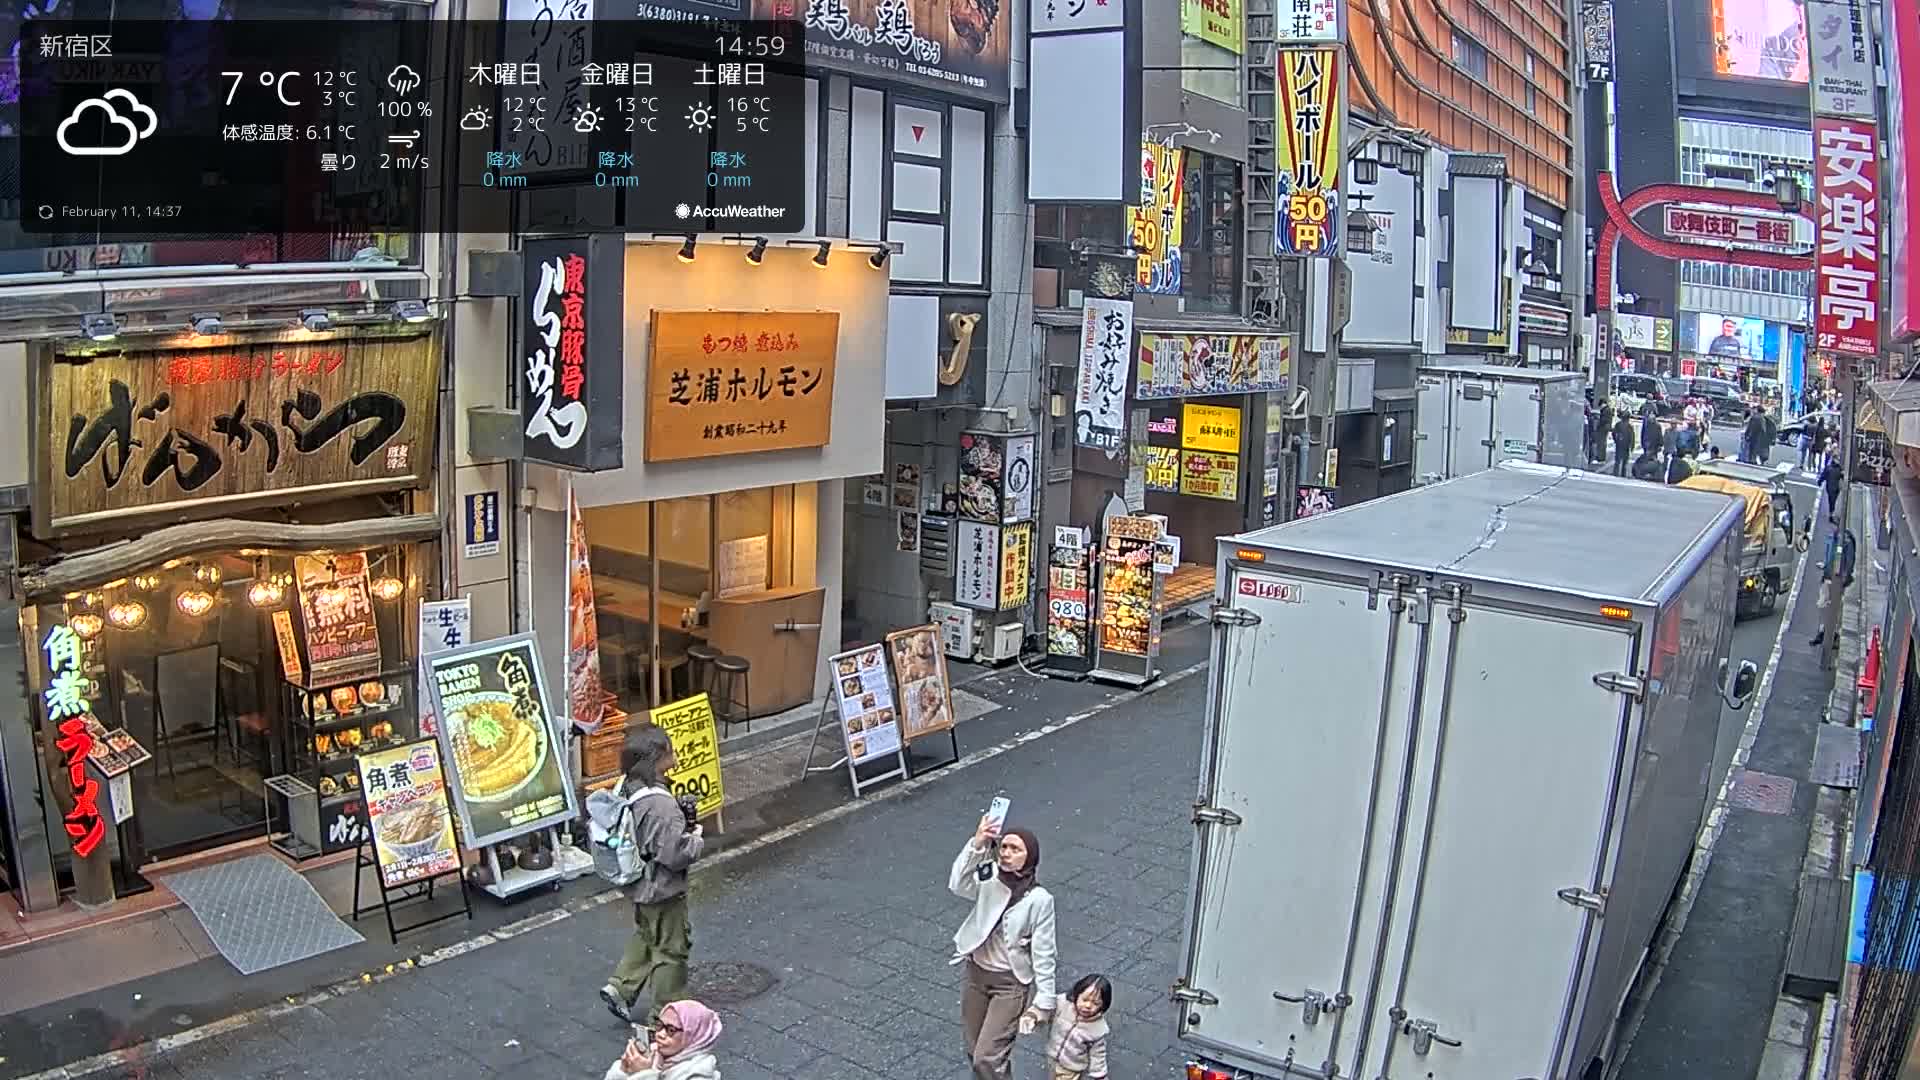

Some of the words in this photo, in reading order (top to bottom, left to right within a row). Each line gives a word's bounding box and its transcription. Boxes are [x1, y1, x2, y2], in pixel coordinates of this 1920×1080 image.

[1295, 52, 1322, 191] ハイボール
[1670, 211, 1790, 242] 歌舞伎町一番街
[1819, 126, 1876, 330] 安楽亭
[561, 252, 585, 400] 東京豚骨
[1818, 333, 1837, 348] 2F
[1095, 309, 1126, 416] お好み焼き
[668, 365, 823, 406] 芝浦ホルモン
[1095, 433, 1120, 448] B1F
[1051, 600, 1084, 616] 980
[436, 663, 480, 683] TOKYO
[438, 677, 482, 695] RAMEN
[661, 706, 708, 726] ハッピーアワー
[366, 762, 412, 793] 角煮
